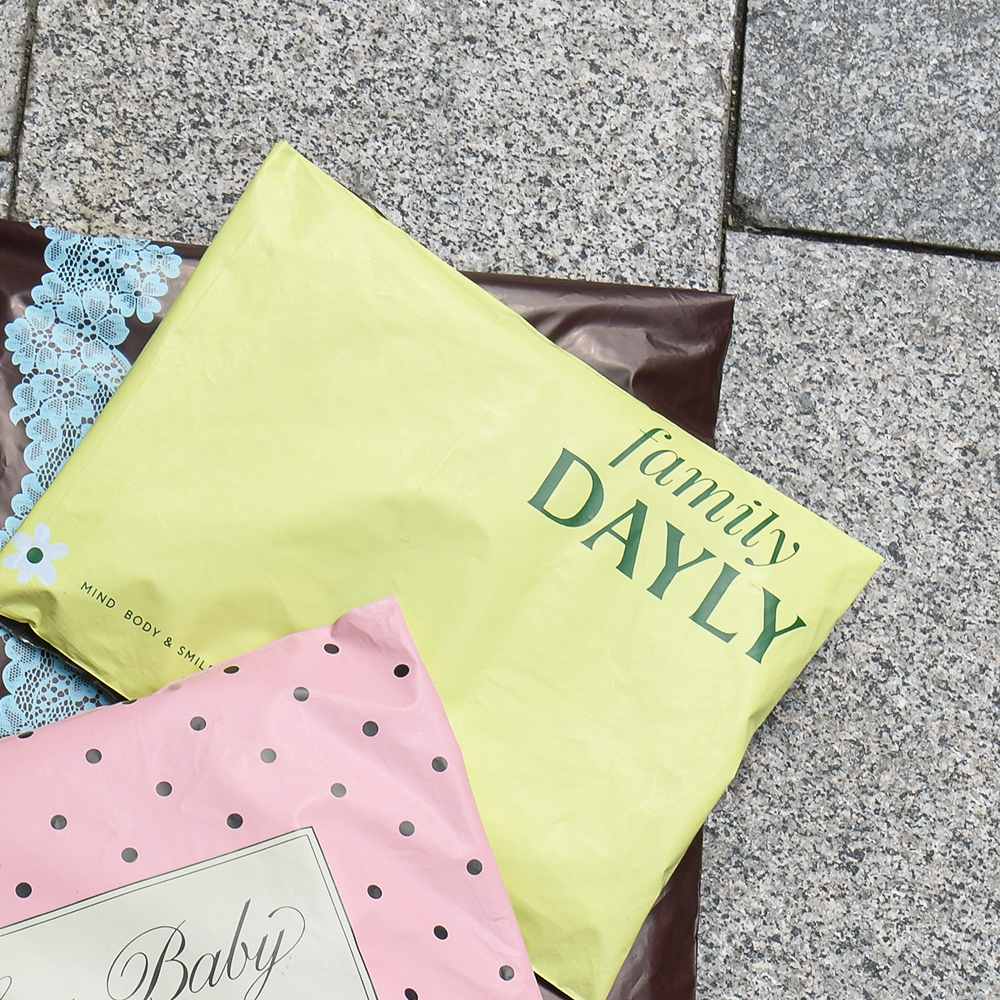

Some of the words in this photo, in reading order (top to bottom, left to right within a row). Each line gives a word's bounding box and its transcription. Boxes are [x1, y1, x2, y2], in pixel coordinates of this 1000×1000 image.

[527, 447, 807, 664] DAYLY
[608, 428, 800, 567] family
[81, 581, 116, 609] MIND
[124, 609, 161, 637] BODY
[163, 636, 173, 648] &
[177, 646, 213, 671] SMIL
